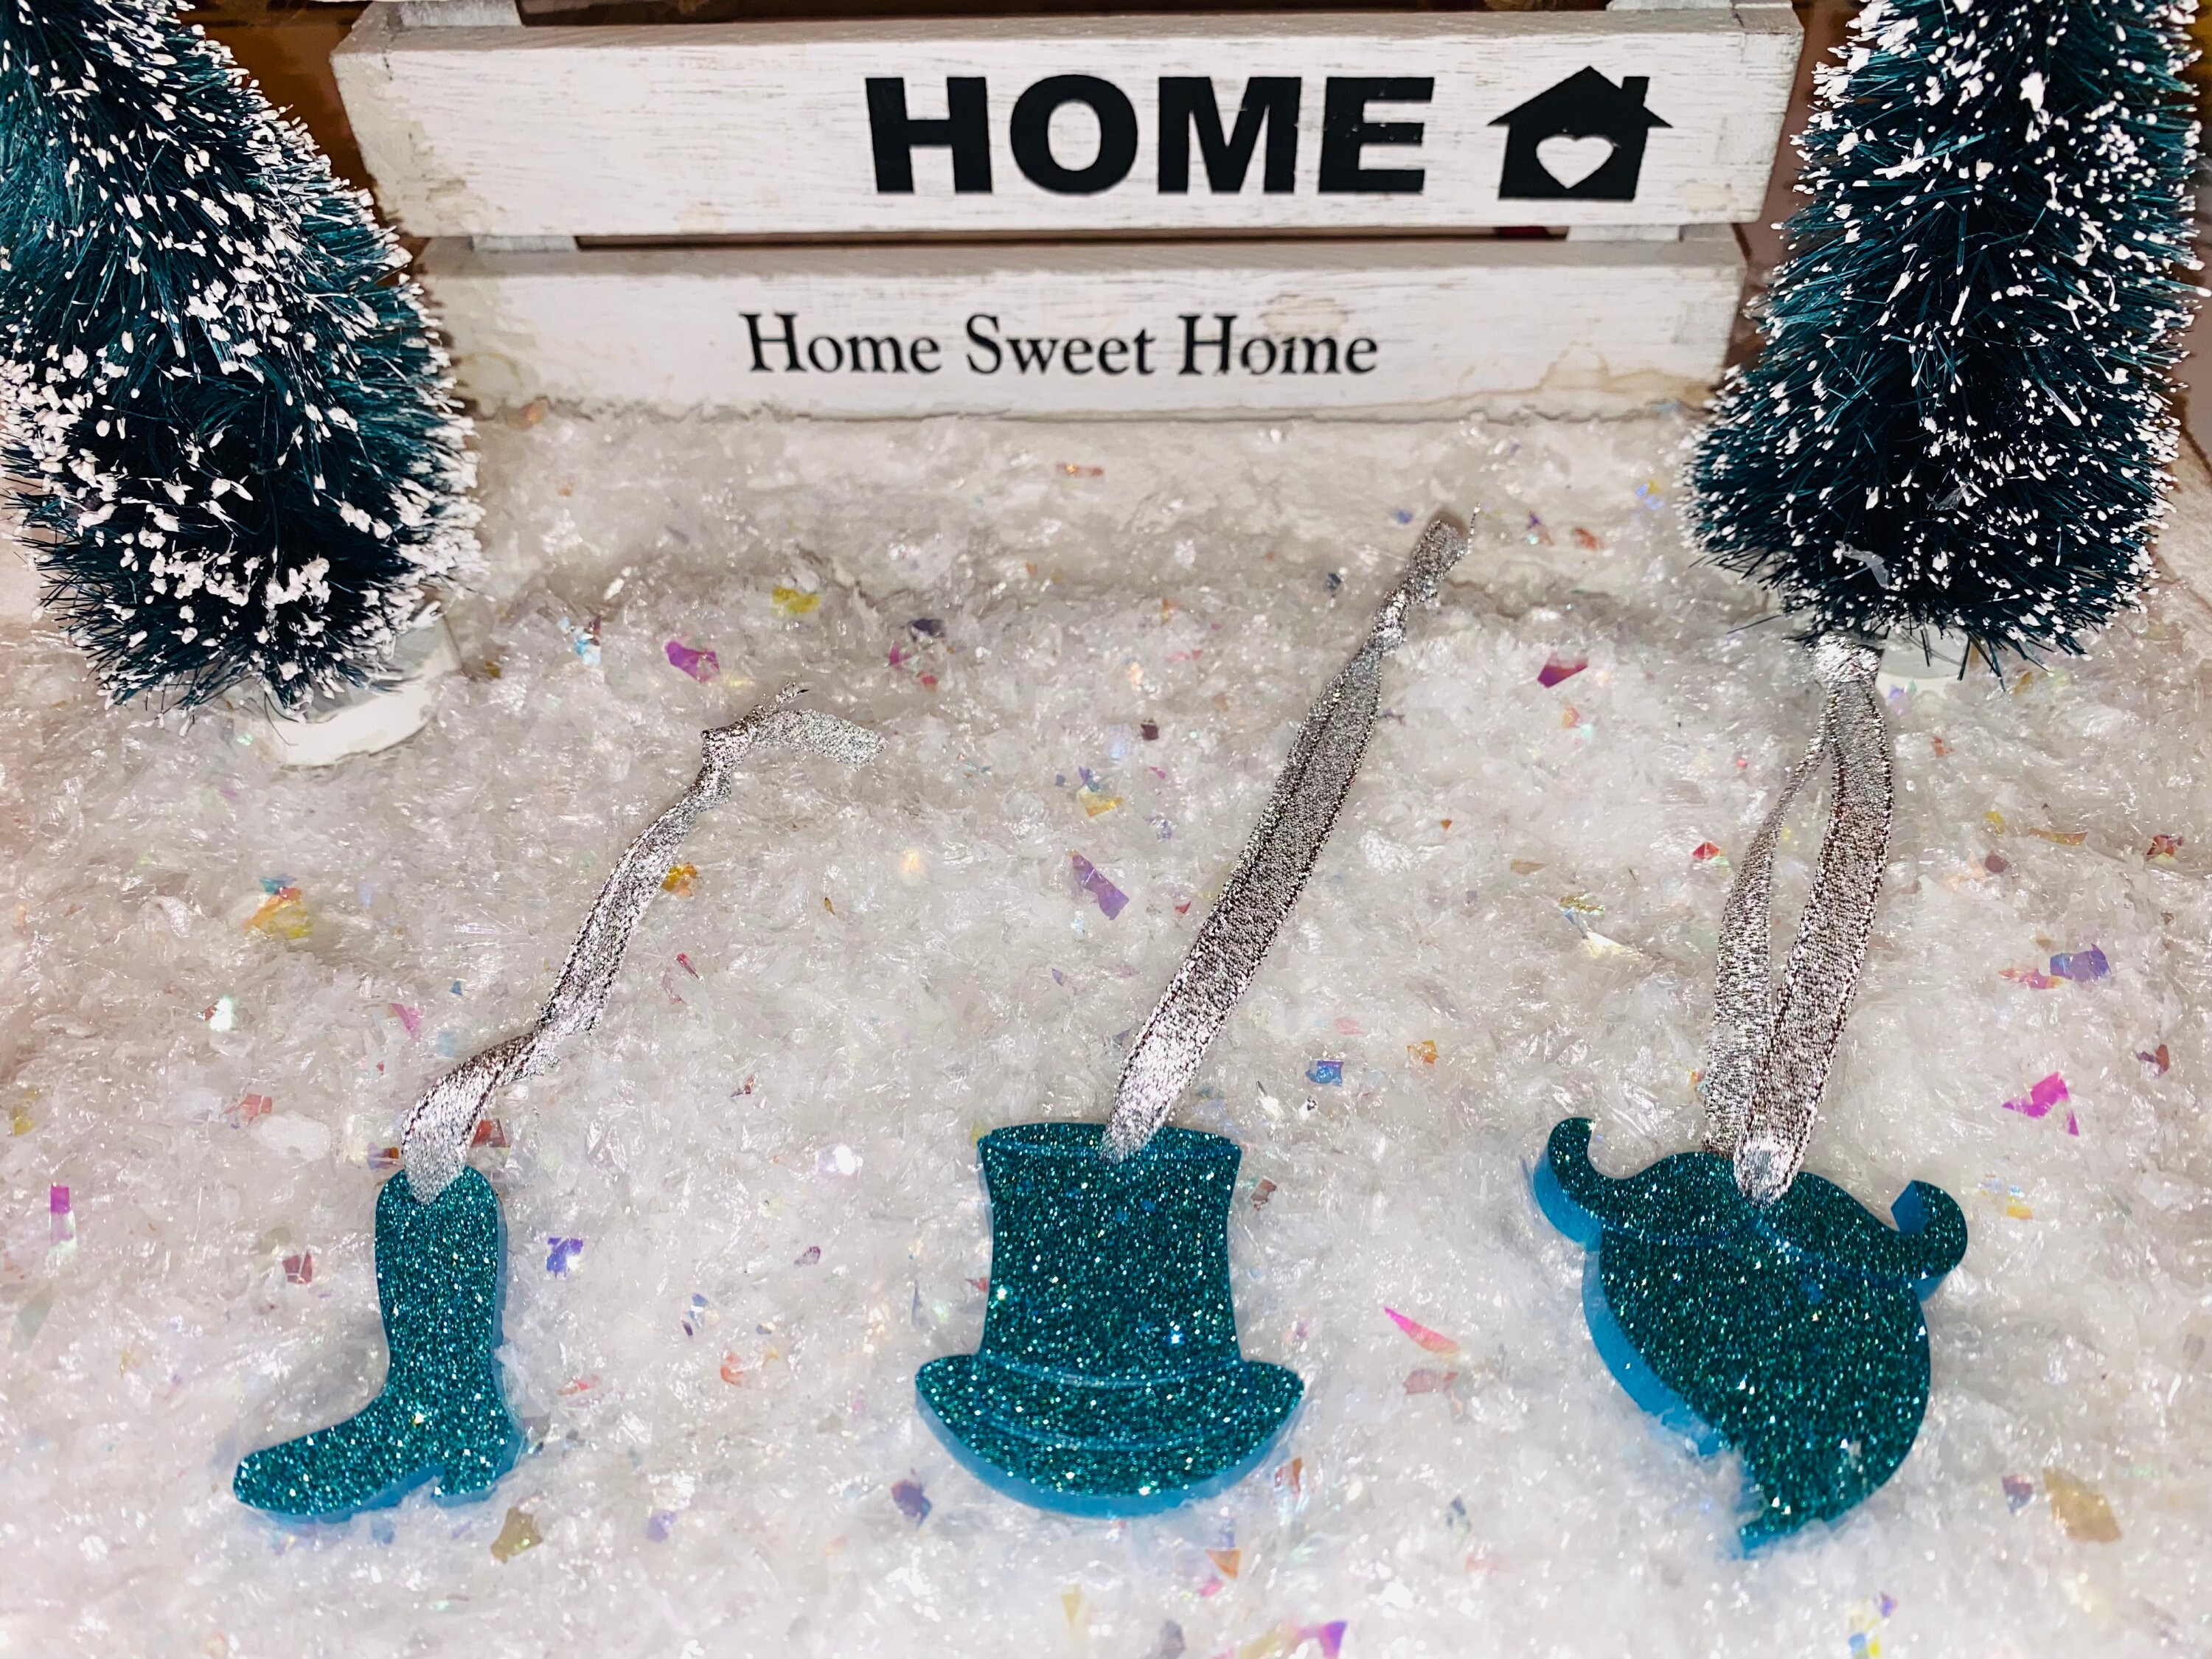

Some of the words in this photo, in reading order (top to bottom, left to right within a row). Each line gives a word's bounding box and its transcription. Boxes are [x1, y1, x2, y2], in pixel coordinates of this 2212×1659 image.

[865, 74, 1435, 195] HOME
[740, 313, 941, 374] Home
[966, 313, 1155, 375] Sweet
[1178, 313, 1378, 375] Home
